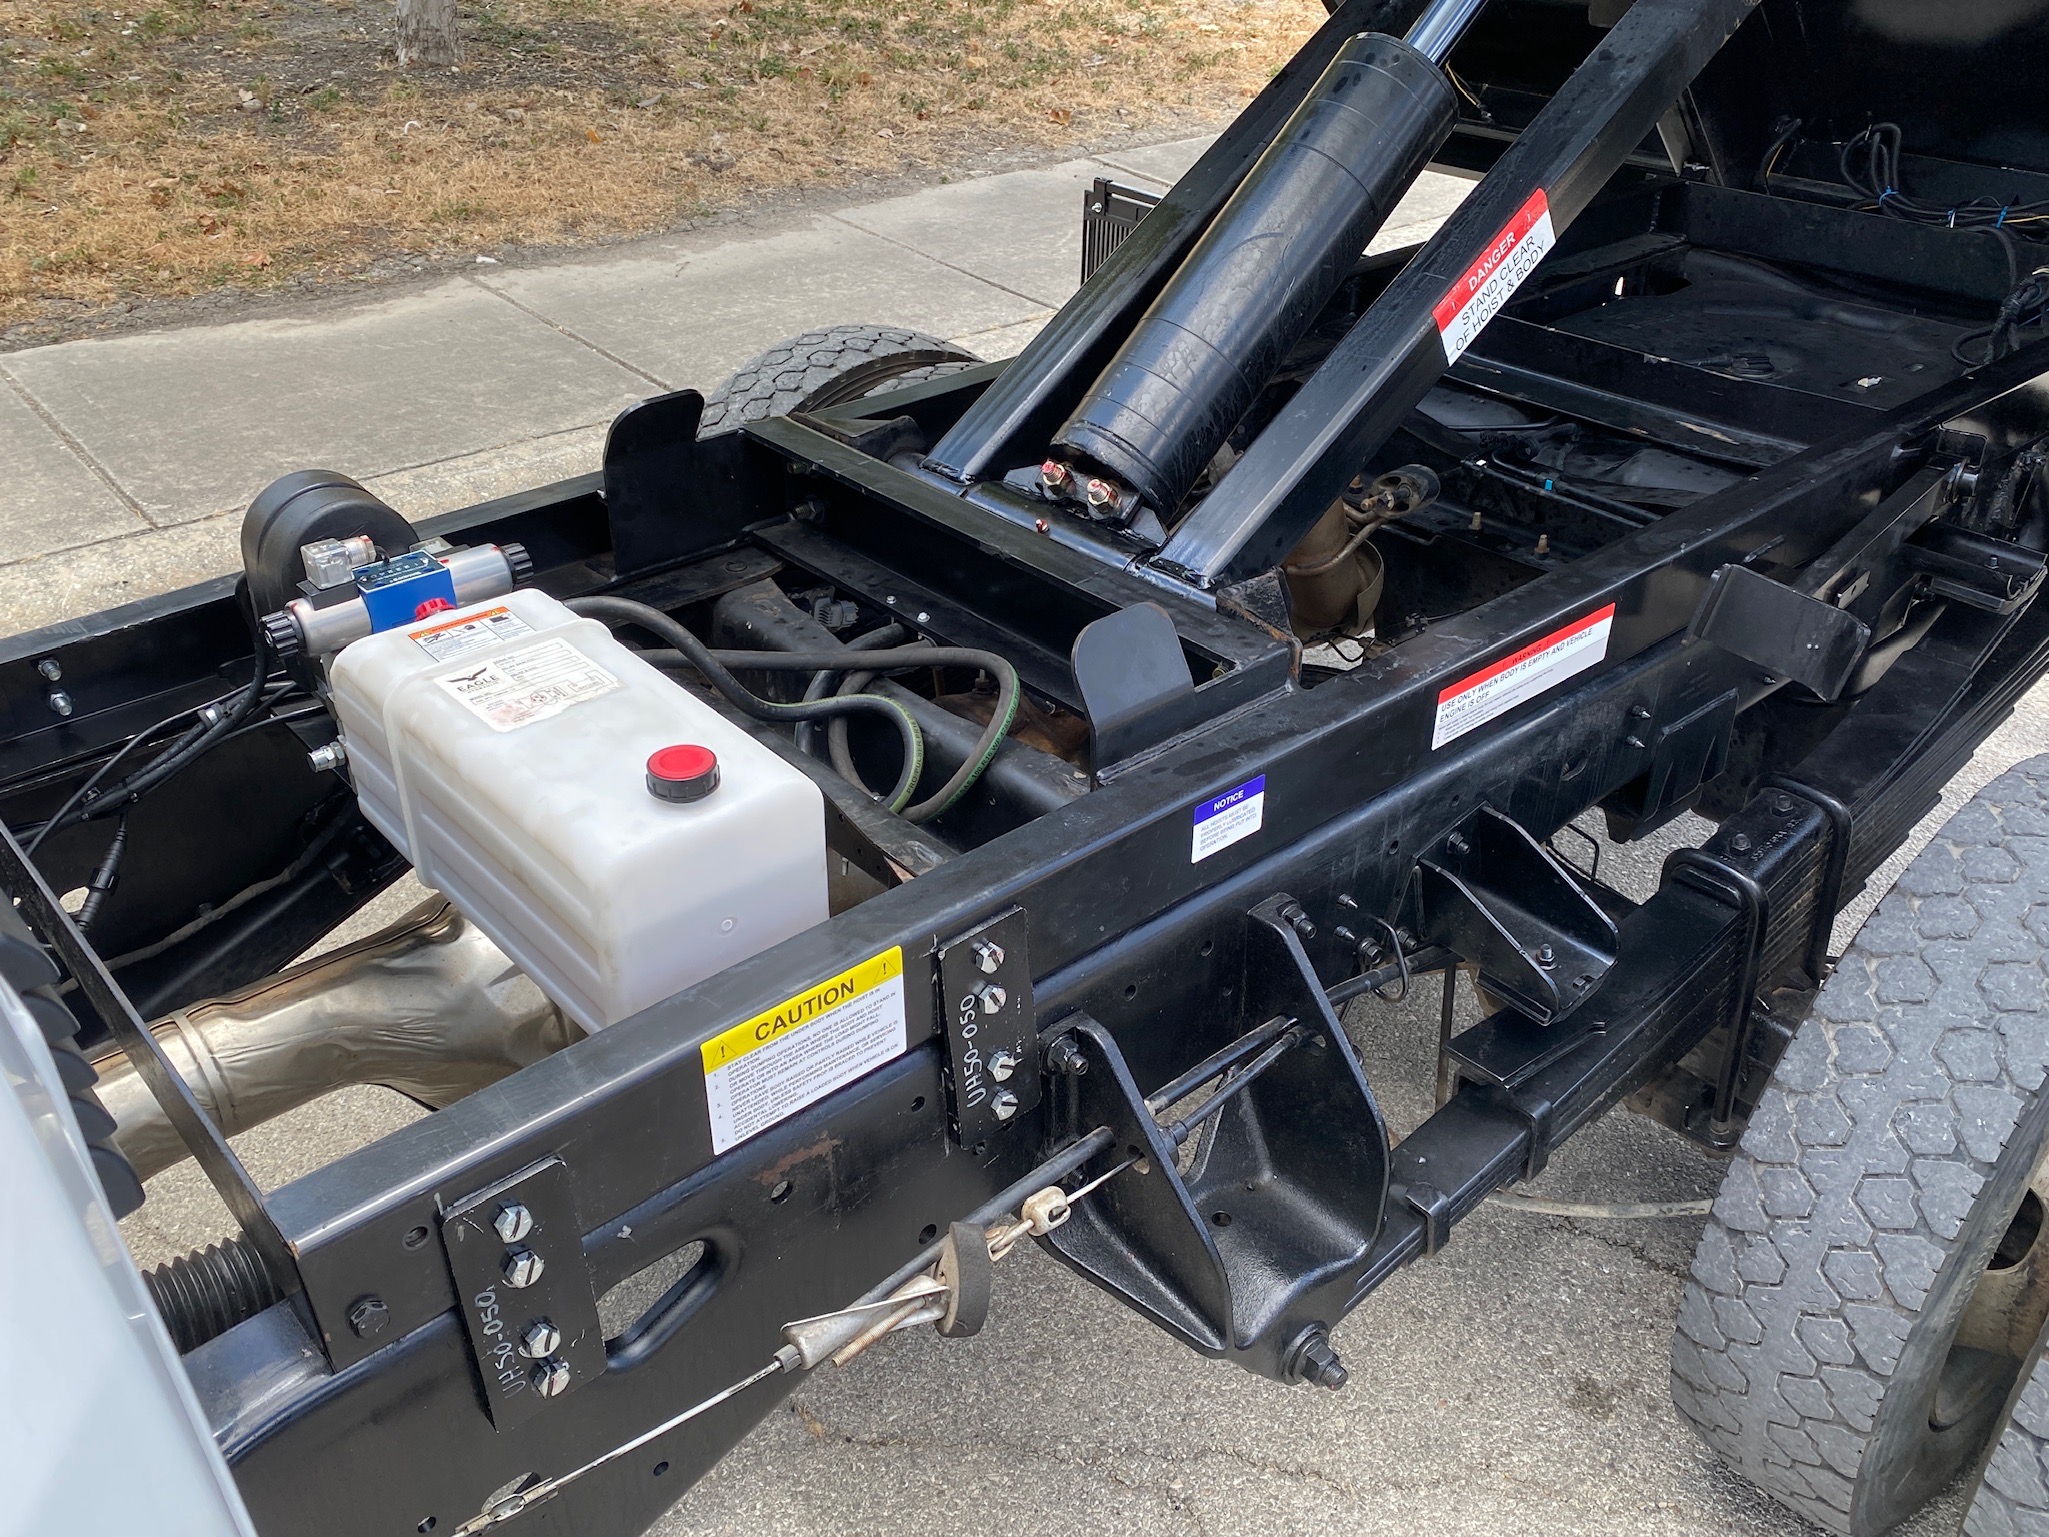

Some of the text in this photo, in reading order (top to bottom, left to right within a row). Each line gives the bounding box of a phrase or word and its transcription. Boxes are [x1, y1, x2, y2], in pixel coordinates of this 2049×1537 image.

[1456, 241, 1543, 351] OF HOIST & BODY
[1462, 236, 1535, 325] STAND CLEAR
[1468, 232, 1515, 291] DANGER
[457, 675, 499, 692] EAGLE
[1441, 628, 1593, 712] USE ONLY WHEN BODY IS EMPTY AND VEHICLE
[1513, 644, 1541, 664] WARNING
[1440, 703, 1466, 722] ENGINE
[1468, 699, 1474, 707] IS
[1476, 691, 1489, 703] OFF
[1200, 831, 1219, 845] BEFORE
[1220, 824, 1234, 834] BEING
[1245, 813, 1256, 821] INTO
[1201, 807, 1255, 838] PROPERLY LUBRICATED
[1210, 815, 1228, 827] HOISTS
[1229, 808, 1241, 817] MUST
[1214, 790, 1244, 811] NOTICE
[728, 1060, 741, 1070] STAY
[743, 1050, 761, 1062] CLEAR
[763, 1041, 778, 1051] FROM
[779, 1034, 789, 1042] THE
[791, 1025, 809, 1036] UNDER
[810, 1017, 824, 1027] BODY
[826, 1009, 841, 1018] WHEN
[842, 1002, 852, 1010] THE
[853, 994, 868, 1004] HOIST
[729, 1068, 750, 1082] DURING
[751, 1055, 776, 1071] DUMPING
[822, 1024, 832, 1033] ONE
[840, 1008, 864, 1024] ALLOWED
[873, 995, 890, 1006] STAND
[739, 1072, 754, 1083] MOVE
[755, 1057, 782, 1074] THROUGH
[783, 1051, 793, 1059] THE
[795, 1044, 809, 1053] AREA
[810, 1033, 828, 1045] WHERE
[841, 1019, 855, 1029] BODY
[856, 1013, 867, 1021] AND
[868, 1004, 882, 1015] HOIST
[755, 978, 854, 1041] CAUTION
[730, 1078, 755, 1094] OPERATE
[766, 1065, 778, 1075] INTO
[789, 1053, 803, 1062] AREA
[804, 1042, 822, 1054] WHERE
[824, 1036, 833, 1044] THE
[835, 1028, 849, 1038] LOAD
[850, 1019, 865, 1030] MIGHT
[730, 1081, 760, 1100] OPERATOR
[762, 1073, 776, 1083] MUST
[778, 1062, 797, 1075] REMAIN
[807, 1042, 834, 1059] CONTROLS
[836, 1031, 855, 1044] DURING
[856, 1019, 879, 1033] DUMPING
[732, 1099, 750, 1111] NEVER
[751, 1089, 768, 1101] LEAVE
[770, 1081, 784, 1091] BODY
[786, 1070, 805, 1082] RAISED
[815, 1053, 834, 1067] PARTLY
[836, 1044, 854, 1055] RAISED
[855, 1034, 870, 1045] WHILE
[872, 1023, 892, 1036] VEHICLE
[733, 1111, 752, 1123] UNDER
[770, 1089, 791, 1103] UNLESS
[792, 1078, 812, 1091] SAFETY
[813, 1070, 827, 1080] PROP
[834, 1055, 855, 1068] BRACED
[864, 1038, 886, 1052] PREVENT
[771, 1085, 787, 1096] WHILE
[789, 1066, 822, 1087] PERFORMING
[870, 1027, 896, 1043] SERVICING
[959, 994, 987, 1108] UH50-050
[734, 1110, 767, 1129] ACCIDENTAL
[744, 1121, 754, 1130] NOT
[756, 1107, 780, 1123] ATTEMPT
[790, 1093, 805, 1105] RAISE
[811, 1079, 832, 1093] LOADED
[833, 1071, 847, 1081] BODY
[848, 1062, 863, 1073] WHEN
[864, 1050, 884, 1064] VEHICLE
[735, 1125, 759, 1141] UNLEVEL
[474, 1290, 526, 1400] UH50-050
